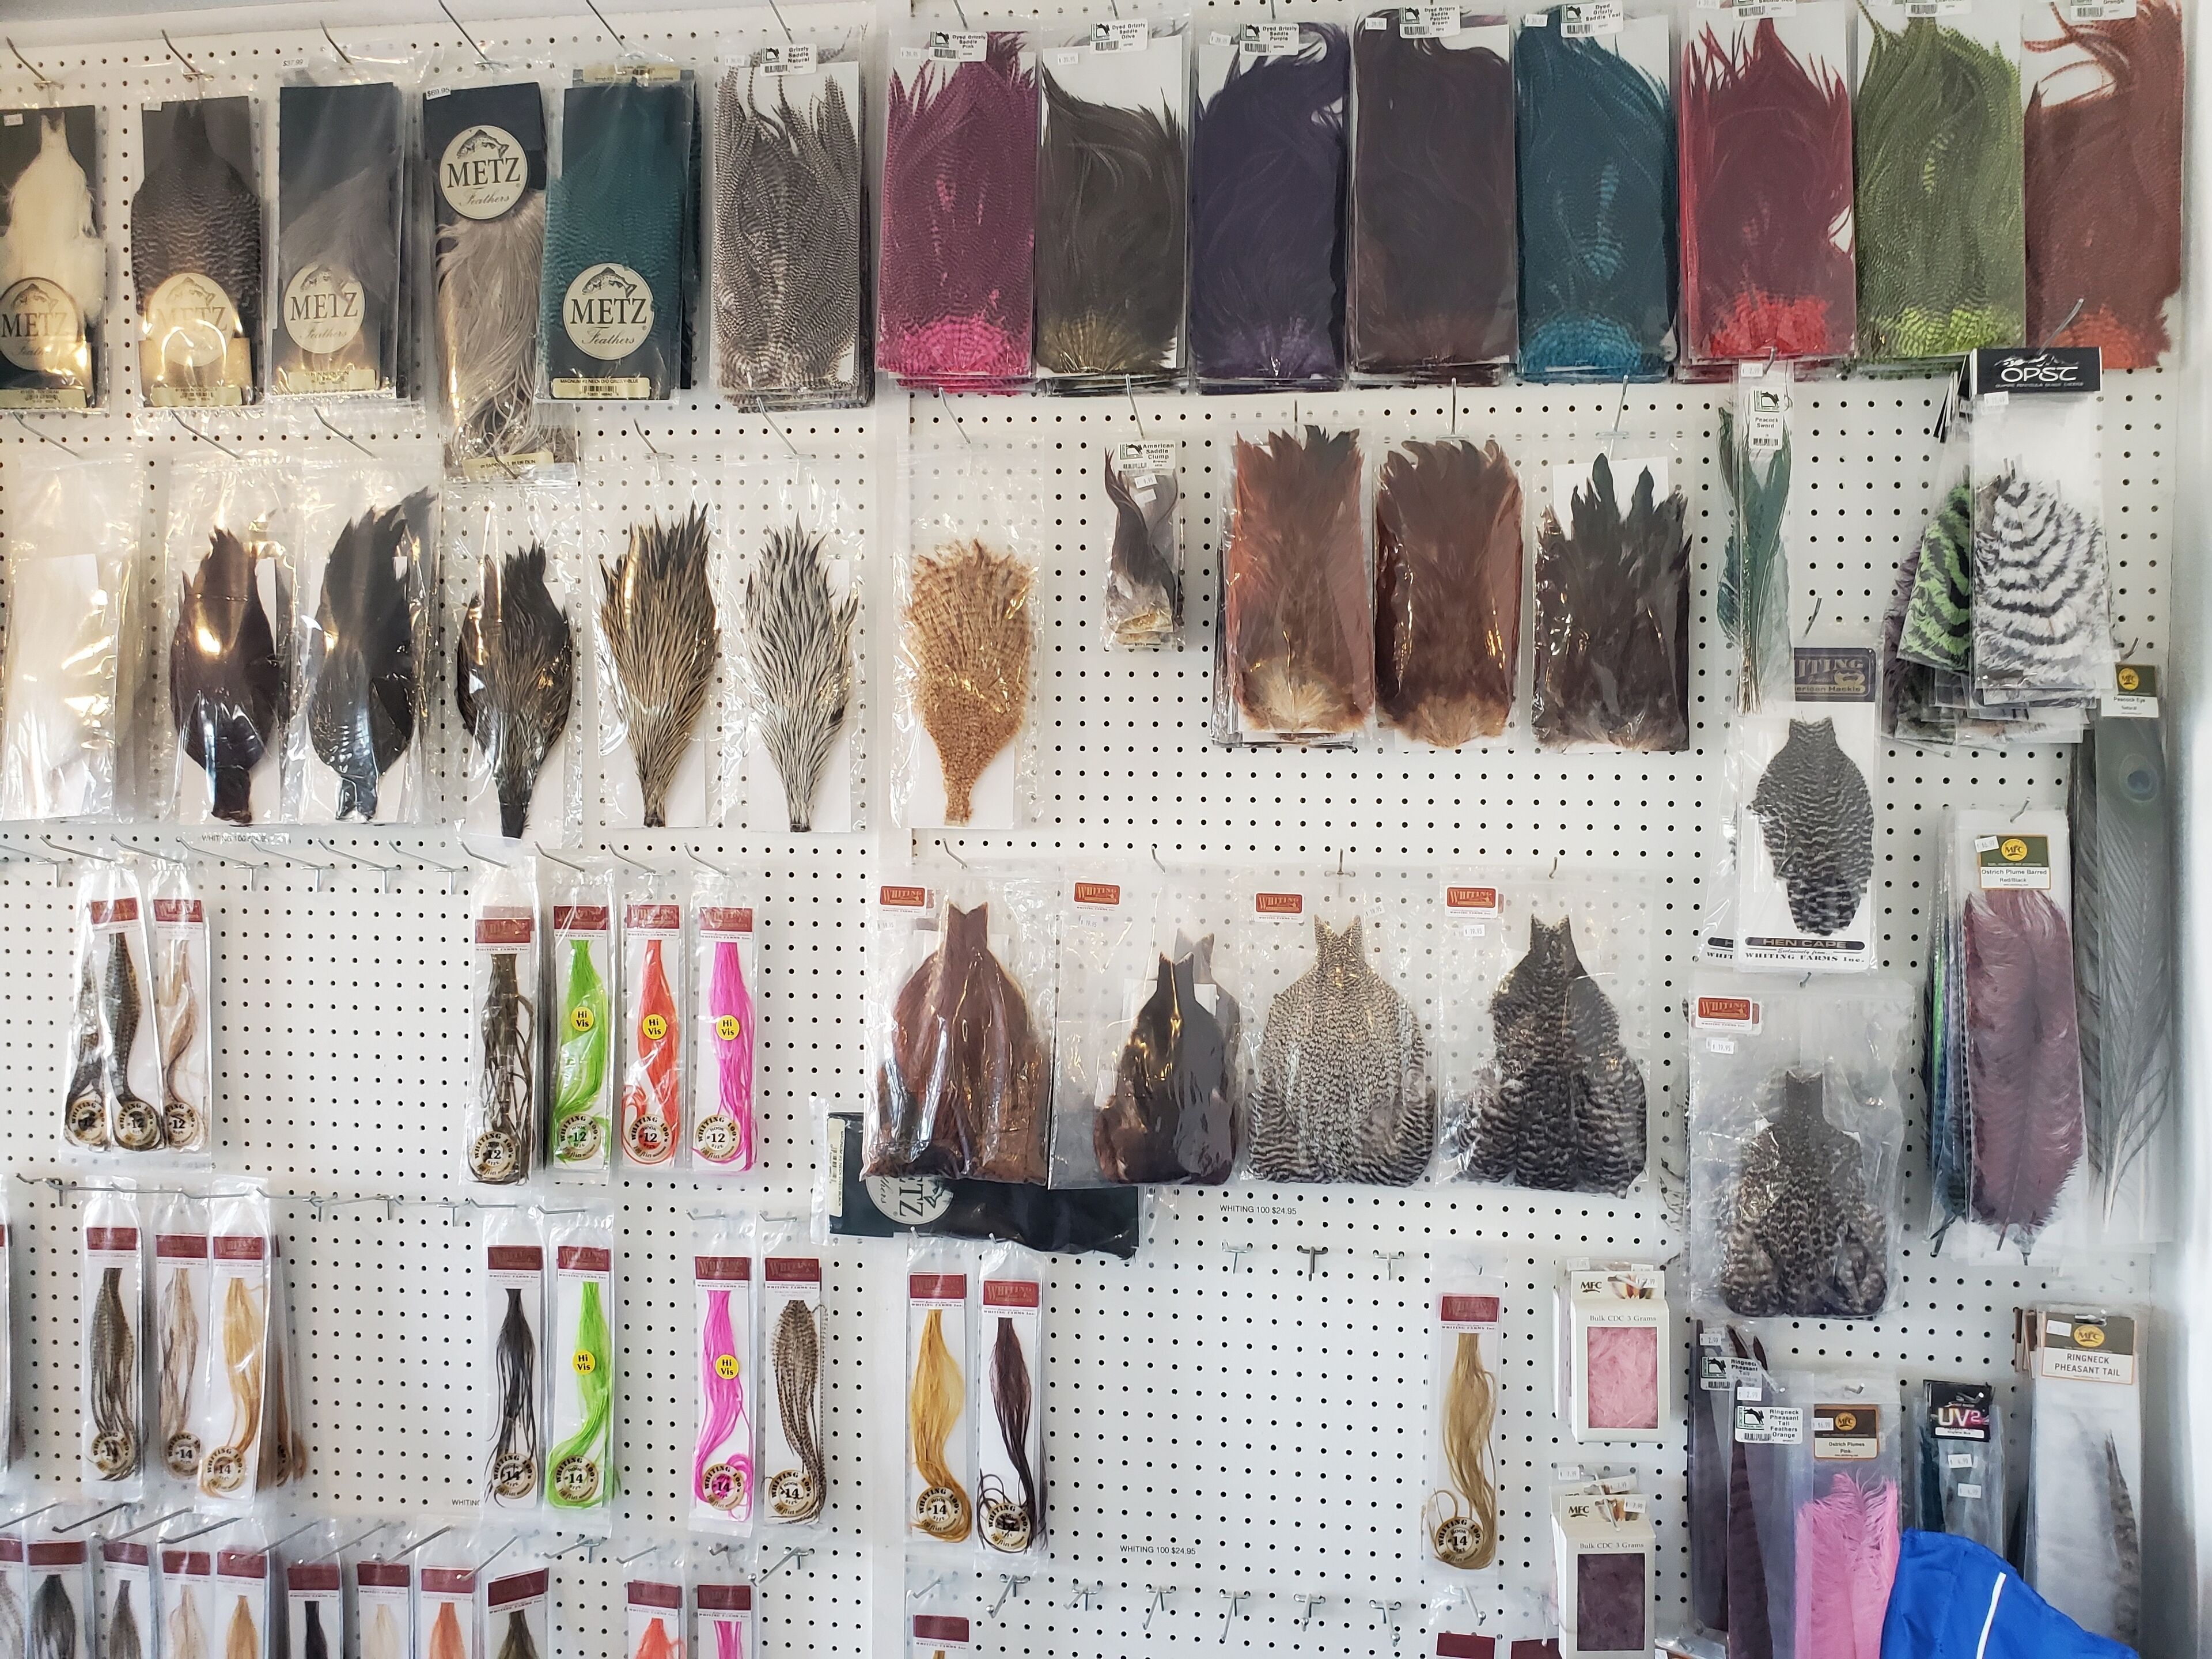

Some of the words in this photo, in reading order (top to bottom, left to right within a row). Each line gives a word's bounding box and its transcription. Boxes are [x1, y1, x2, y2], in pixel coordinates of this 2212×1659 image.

[447, 157, 521, 188] METZ
[459, 191, 510, 208] Feathers
[290, 291, 358, 321] METZ
[570, 298, 647, 324] METZ
[2, 312, 67, 338] METZ
[581, 328, 635, 346] Feathers
[2001, 366, 2079, 382] OPST
[1798, 658, 1864, 677] ITING
[2122, 675, 2137, 683] MFC
[2005, 846, 2023, 854] MFC
[883, 889, 922, 903] WHITING
[1077, 886, 1116, 899] WHITING
[1450, 891, 1492, 903] WHITING
[1259, 896, 1299, 910] WHITING
[1763, 938, 1797, 946] HEN
[1801, 940, 1847, 949] CAPE
[577, 1010, 588, 1019] Hi
[1701, 1001, 1746, 1014] WHITING
[575, 1020, 589, 1028] Vis
[648, 1018, 660, 1027] Hi
[721, 1019, 733, 1028] Hi
[647, 1027, 662, 1036] Vis
[721, 1028, 735, 1036] Vis
[560, 1115, 586, 1142] WHITING
[631, 1116, 658, 1140] WHITING
[698, 1116, 725, 1142] WHITING
[475, 1132, 501, 1159] WHITING
[1219, 1204, 1255, 1213] WHITING
[1257, 1206, 1270, 1214] 100
[1271, 1206, 1297, 1215] $24.95
[770, 1262, 814, 1276] WHITING
[987, 1285, 1032, 1300] WHITING
[1580, 1281, 1603, 1290] MFC
[2078, 1332, 2100, 1340] MFC
[577, 1354, 589, 1363] Hi
[721, 1358, 733, 1368] Hi
[2067, 1353, 2109, 1364] RINGNECK
[576, 1362, 592, 1372] Vis
[720, 1367, 734, 1377] Vis
[2055, 1363, 2100, 1375] PHEASANT
[2103, 1368, 2120, 1377] TAIL
[207, 1448, 232, 1473] WHITING
[493, 1455, 520, 1480] WHITING
[556, 1457, 583, 1483] WHITING
[704, 1465, 731, 1490] WHITING
[772, 1472, 799, 1498] WHITING
[919, 1488, 946, 1514] WHITING
[988, 1505, 1016, 1528] WHITING
[1568, 1505, 1589, 1514] MFC
[1438, 1519, 1468, 1547] WHITING
[1120, 1545, 1154, 1554] WHITING
[1157, 1546, 1170, 1554] 100
[1171, 1547, 1196, 1555] $24.95
